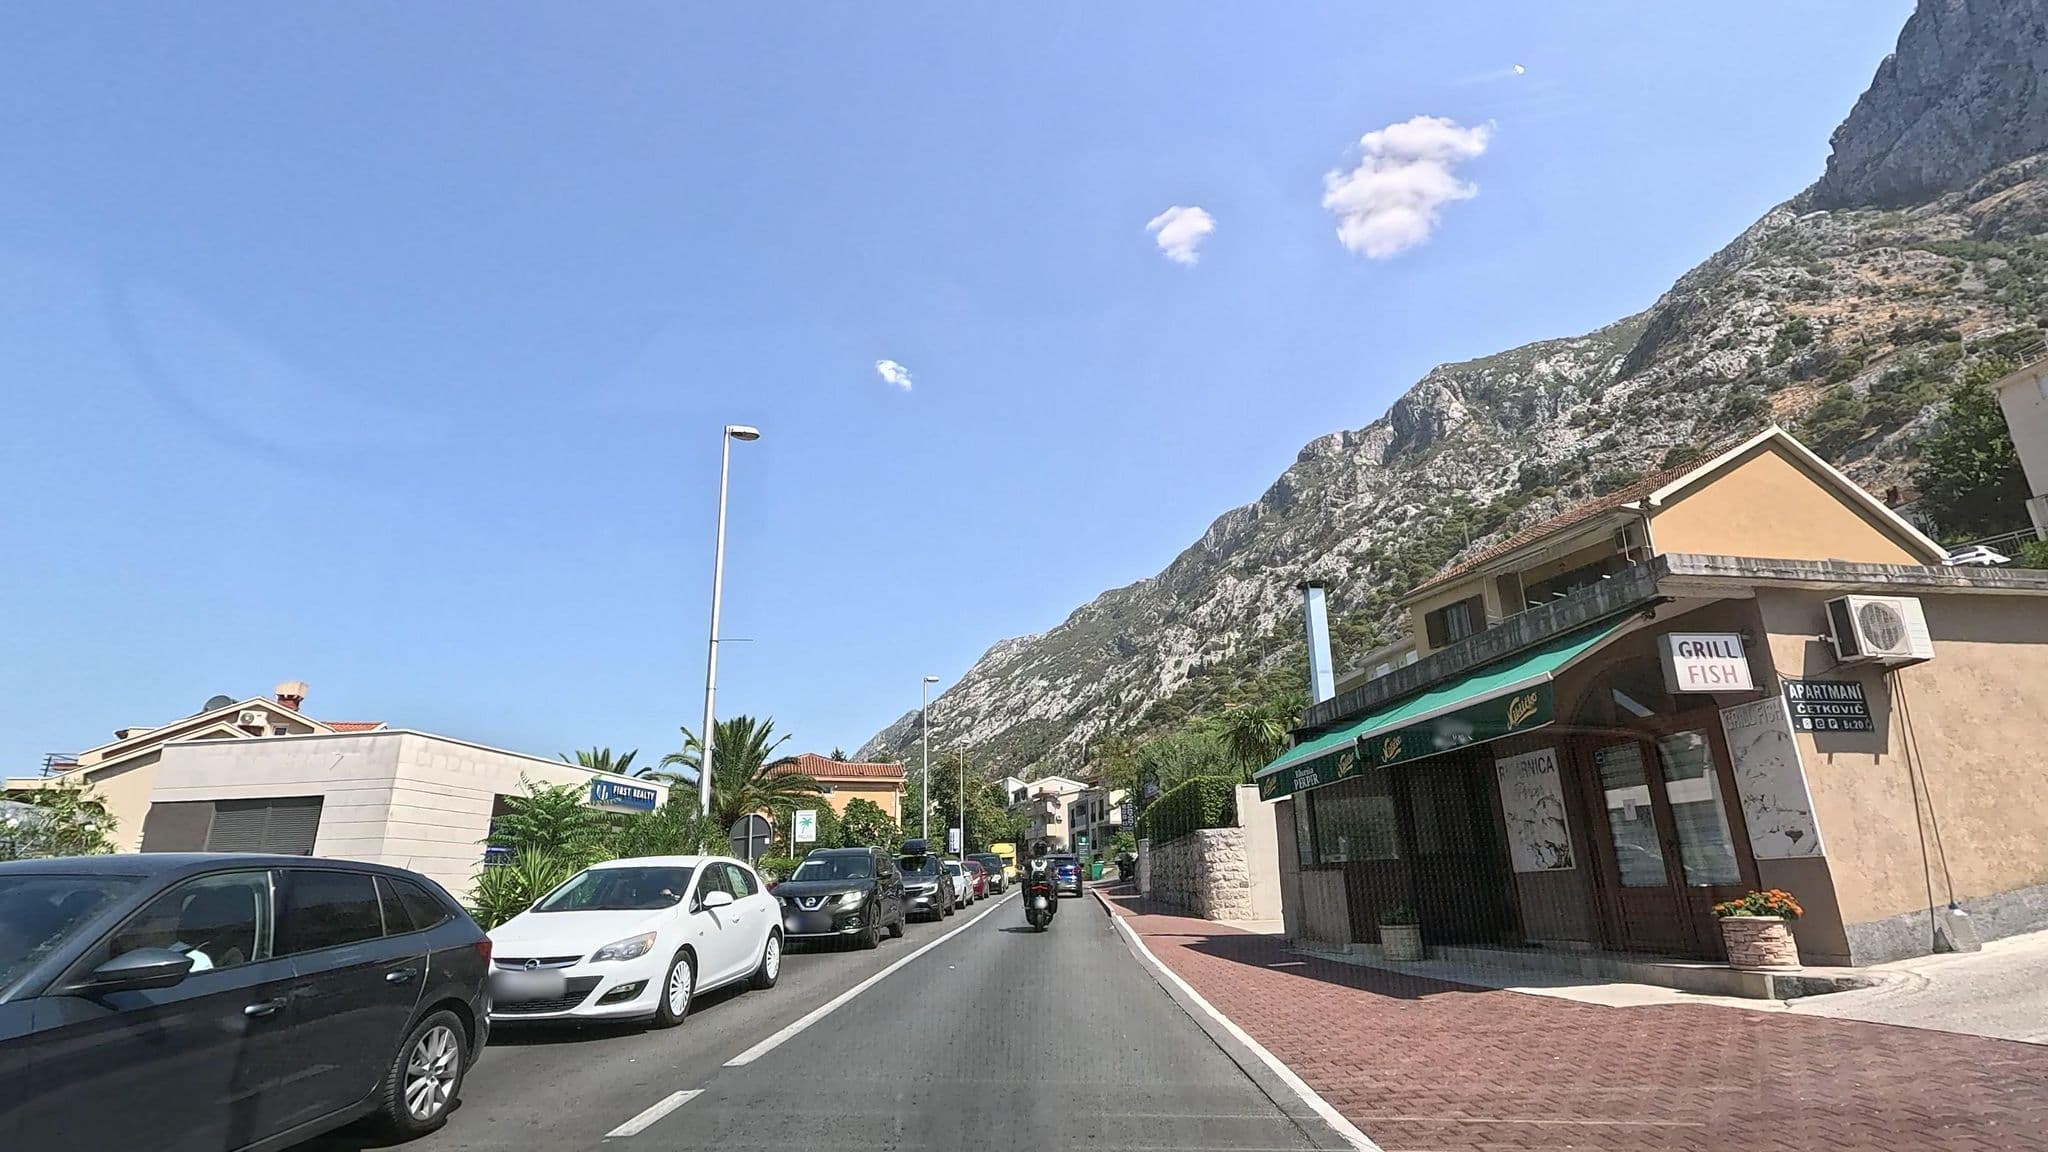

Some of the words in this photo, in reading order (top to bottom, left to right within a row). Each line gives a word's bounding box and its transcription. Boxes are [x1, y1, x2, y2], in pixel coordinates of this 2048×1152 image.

[1678, 640, 1739, 660] GRILL
[1687, 665, 1739, 684] FISH
[1789, 683, 1863, 700] APARTMANI
[1498, 755, 1555, 781] RRNICA
[613, 785, 630, 796] FIRST
[633, 789, 655, 800] REALTY
